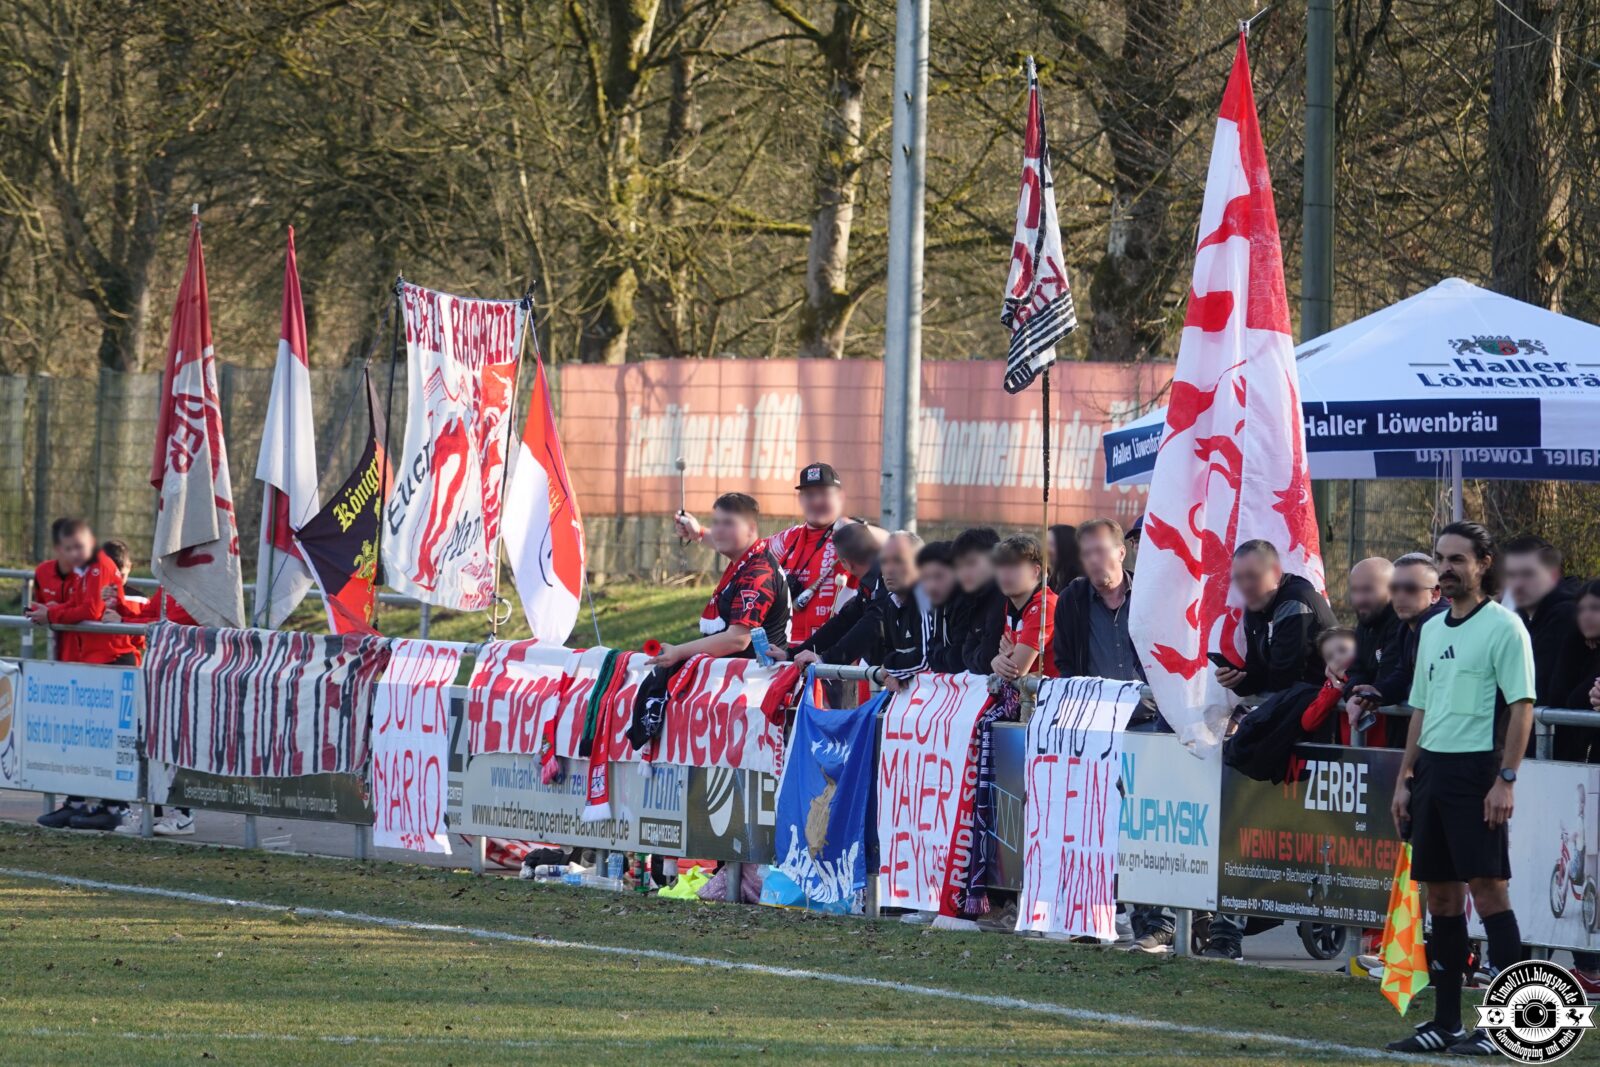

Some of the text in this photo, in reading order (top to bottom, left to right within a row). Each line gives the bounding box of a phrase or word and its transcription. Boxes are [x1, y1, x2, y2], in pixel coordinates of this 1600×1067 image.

[1416, 373, 1600, 388] Löwenbrä
[1452, 358, 1572, 373] Haller
[625, 392, 802, 480] Tradition seit 1919
[1303, 411, 1498, 437] Haller Löwenbräu
[917, 407, 1024, 487] illkommen
[1023, 409, 1061, 489] bi
[1058, 410, 1101, 491] der
[1113, 431, 1161, 467] Haller Löwenbr
[70, 679, 114, 714] Therapeuten
[379, 639, 459, 736] SUPER
[886, 670, 969, 751] LEON
[62, 718, 82, 752] guten
[373, 749, 441, 840] MARIO
[878, 748, 955, 836] MAIER
[1026, 755, 1058, 840] IST
[1063, 757, 1110, 848] EIN
[1304, 760, 1368, 814] ZERBE
[1119, 798, 1209, 847] AUPHYSIK
[949, 809, 976, 889] RUDE
[1118, 850, 1209, 876] w.gn-bauphysik.com
[1239, 828, 1276, 860] WENN
[1279, 831, 1293, 861] ES
[1295, 833, 1314, 864] UM
[1339, 836, 1372, 868] DACH
[1375, 839, 1401, 871] GEH
[1053, 846, 1115, 934] MANN
[1224, 860, 1283, 883] Flachdachabdichtungen
[1336, 872, 1380, 891] Flaschnerarbeiten
[1221, 895, 1247, 911] Hirschgasse
